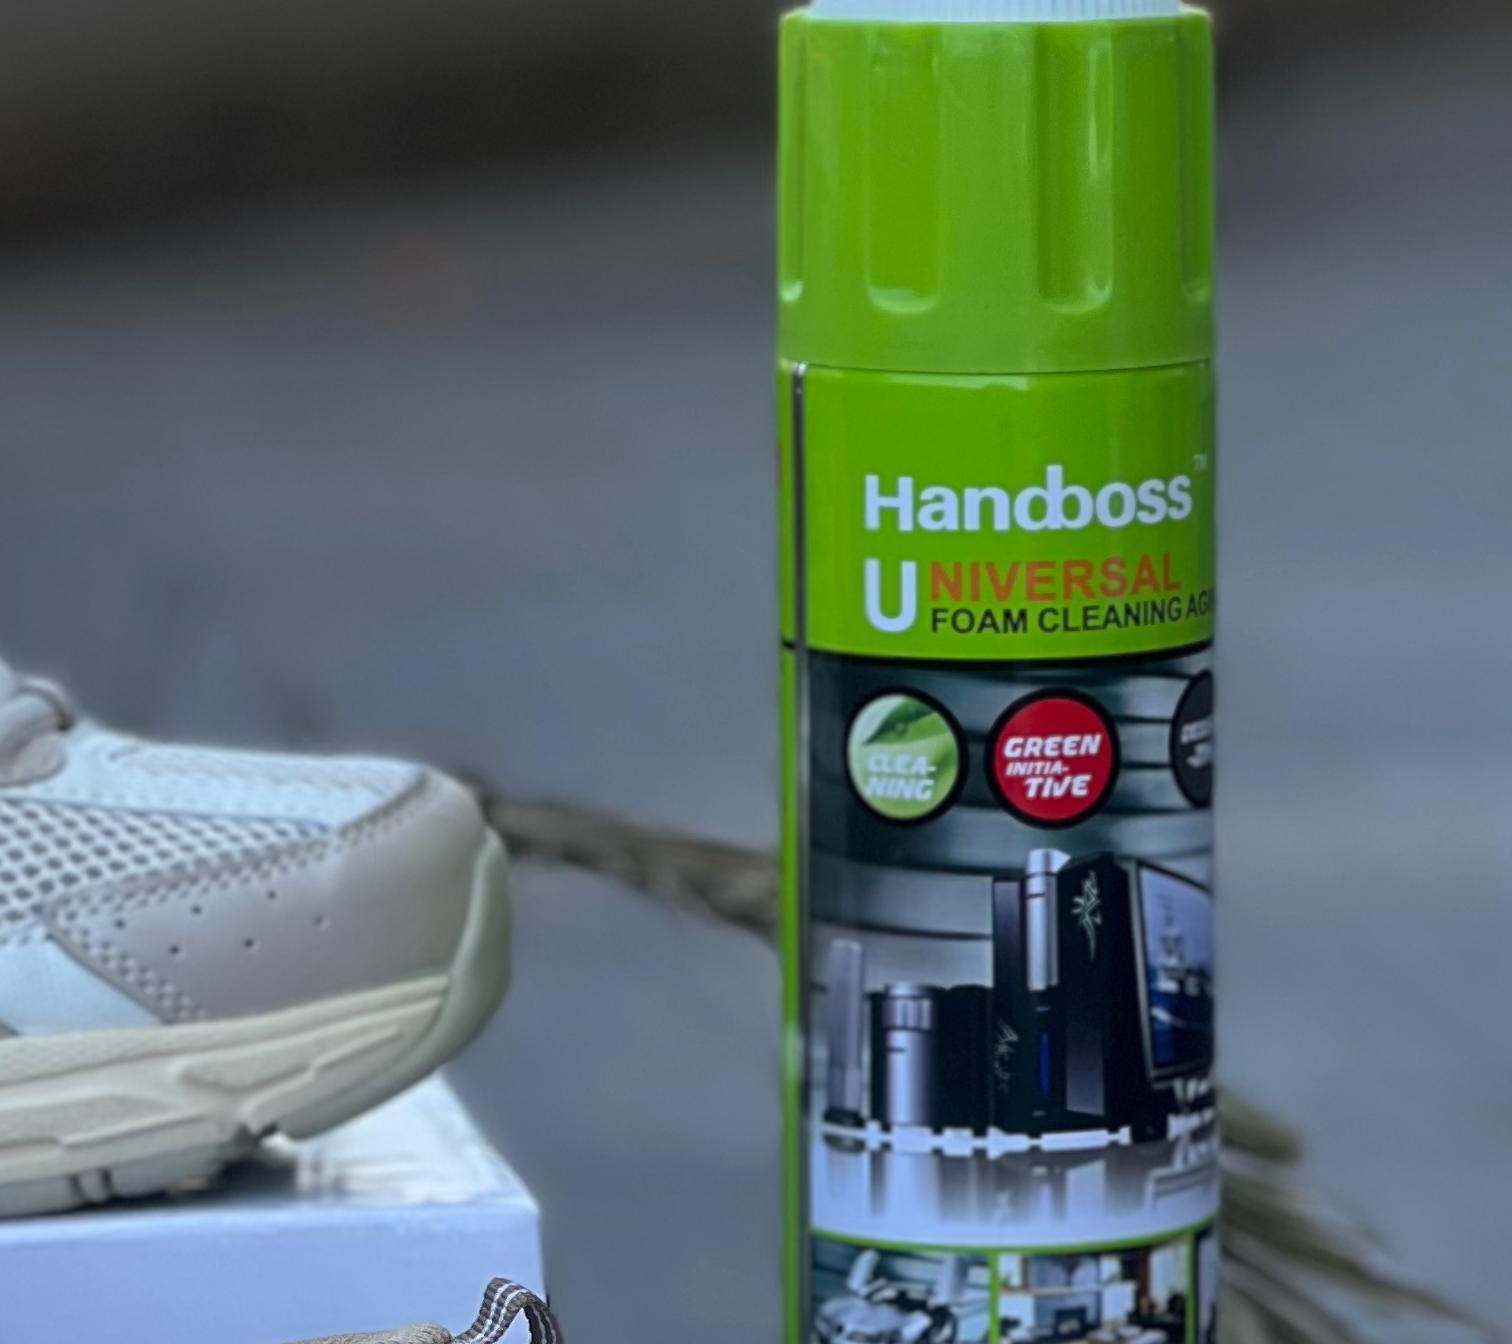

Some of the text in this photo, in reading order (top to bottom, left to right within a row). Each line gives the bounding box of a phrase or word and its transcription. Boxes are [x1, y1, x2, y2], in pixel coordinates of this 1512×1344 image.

[863, 465, 1193, 532] Handboss
[931, 608, 1030, 635] FOAM
[1038, 597, 1182, 633] CLEANING
[1004, 734, 1102, 757] GREEN
[866, 777, 934, 800] NING
[1025, 775, 1092, 799] TIVE
